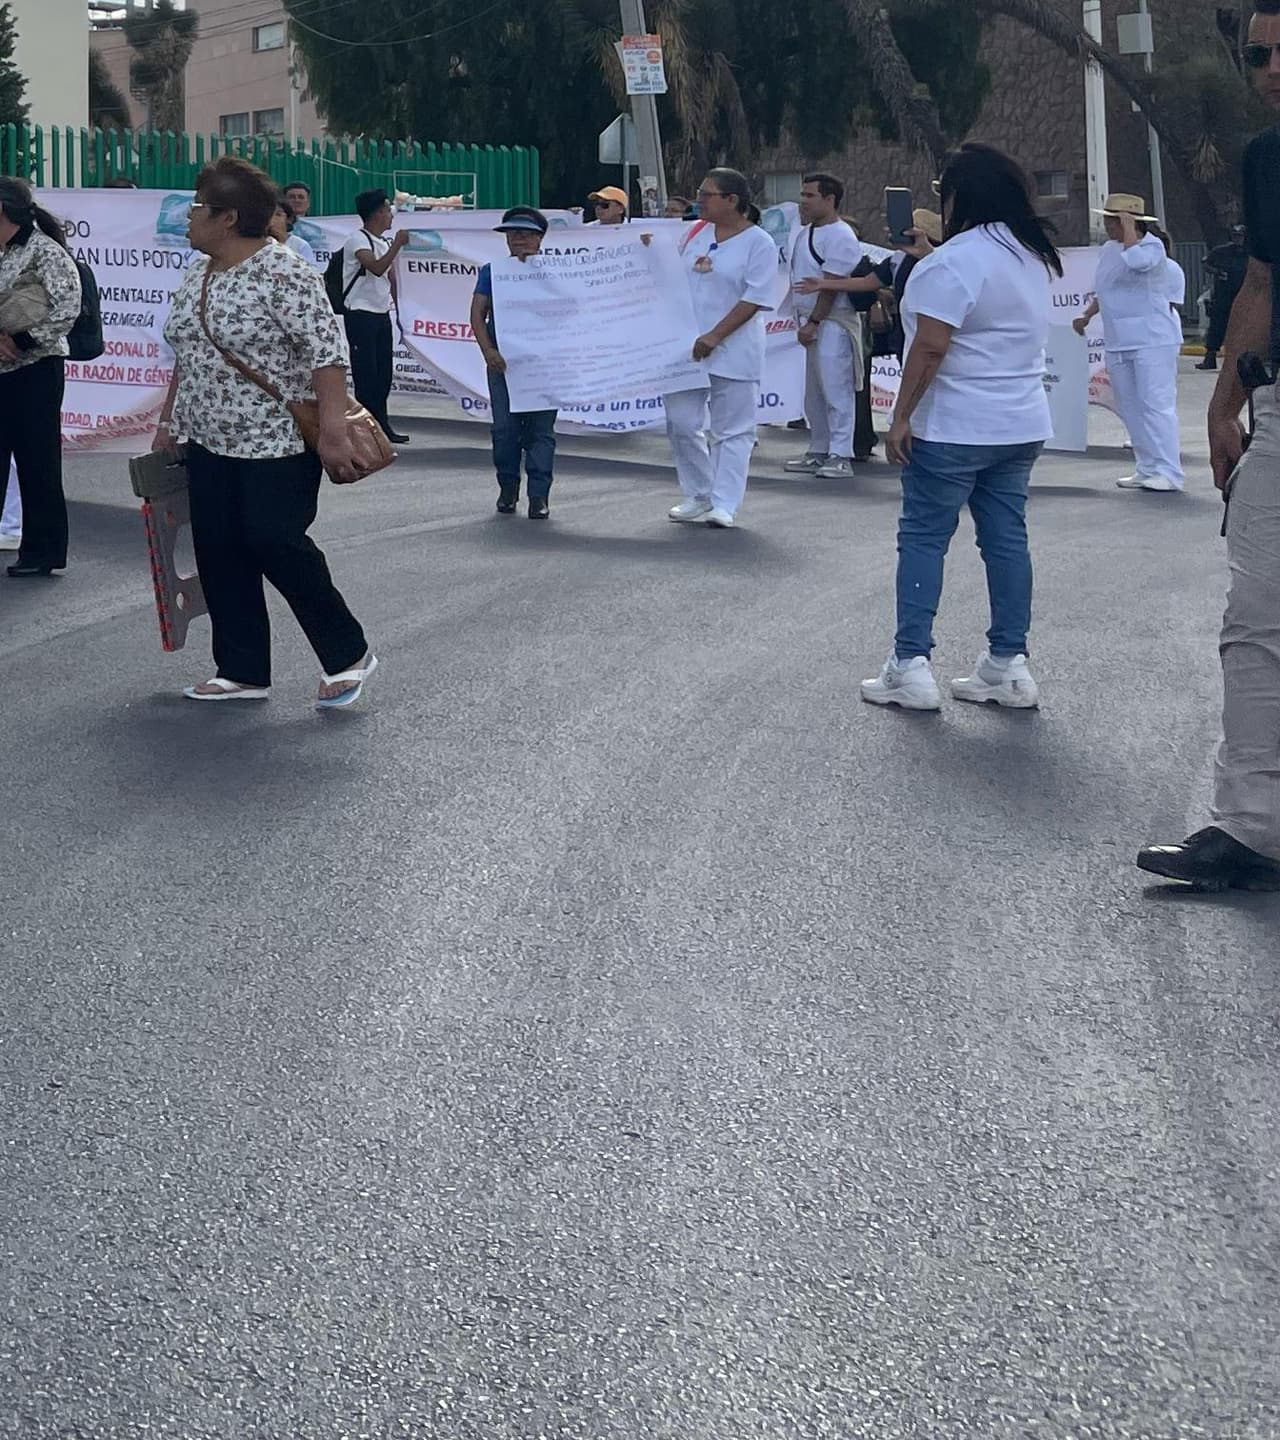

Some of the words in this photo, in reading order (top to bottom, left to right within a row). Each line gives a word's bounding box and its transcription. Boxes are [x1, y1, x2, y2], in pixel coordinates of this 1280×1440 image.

[104, 248, 138, 268] LUIS
[1053, 293, 1080, 307] LUIS
[147, 343, 159, 358] DE
[83, 363, 124, 381] RAZÓN
[127, 368, 141, 381] DE
[611, 400, 630, 411] un
